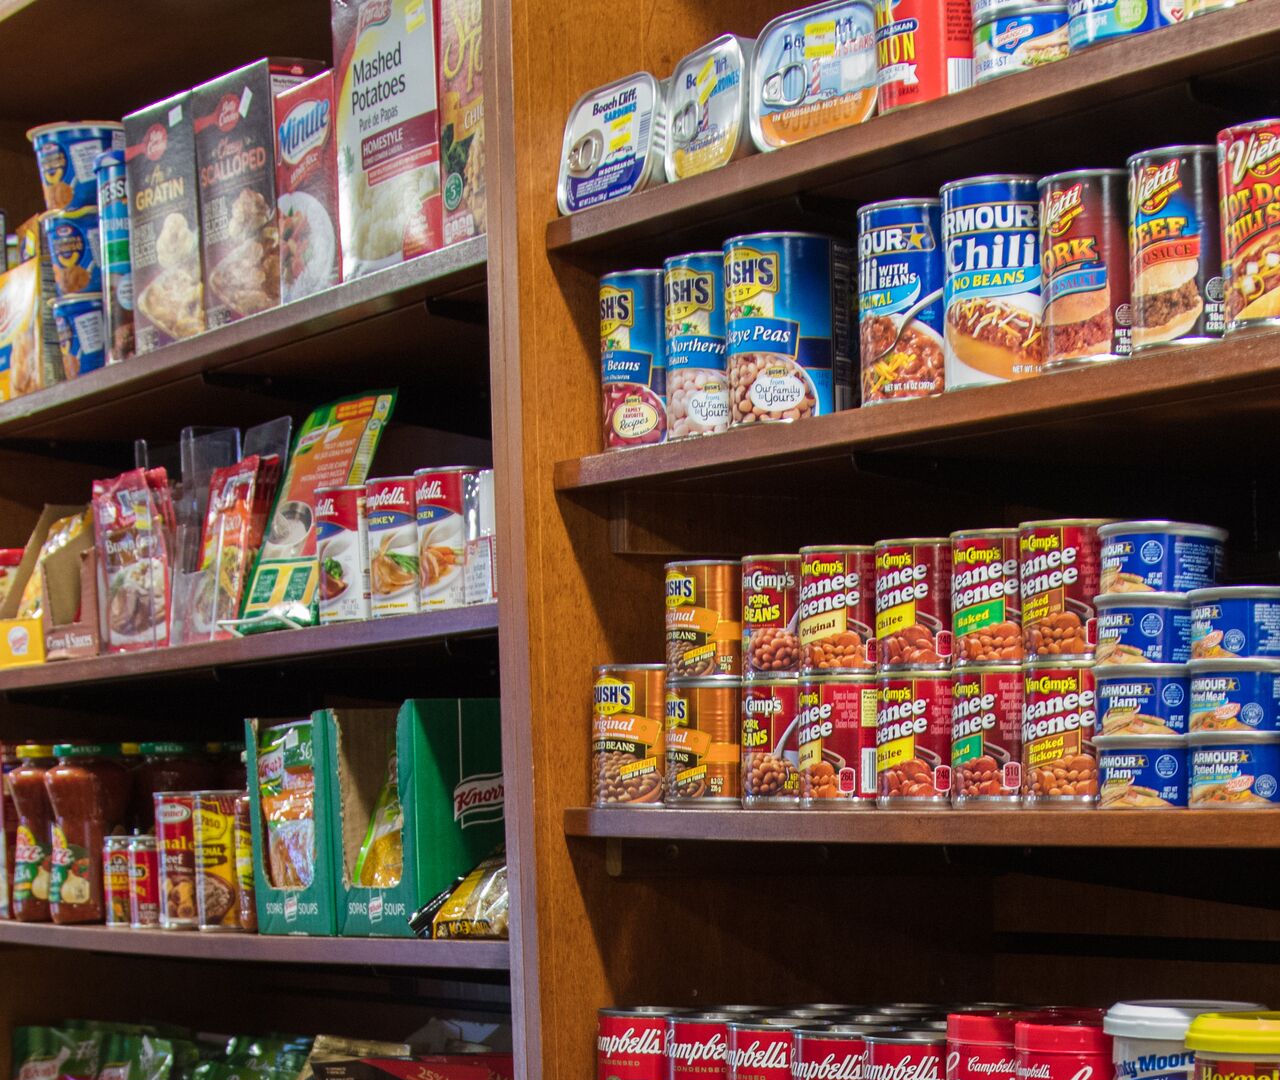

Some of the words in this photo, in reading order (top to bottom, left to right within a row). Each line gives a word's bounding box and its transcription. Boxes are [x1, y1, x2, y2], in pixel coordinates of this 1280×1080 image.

[353, 41, 402, 87] Mashed
[352, 73, 406, 115] Potatoes
[278, 101, 329, 155] Minute
[362, 128, 404, 154] HOMESTYLE
[201, 146, 265, 186] SCALLOPED
[136, 180, 184, 209] GRATIN
[947, 234, 1035, 273] Chili
[878, 263, 909, 277] WITH
[879, 274, 917, 289] BEANS
[953, 274, 970, 291] NO
[972, 270, 1025, 288] BEANS
[753, 324, 792, 344] Peas
[606, 359, 641, 373] Beans
[755, 384, 772, 395] Our
[772, 384, 801, 398] Family
[619, 417, 649, 431] Recipes
[748, 594, 770, 606] PORK
[877, 612, 904, 631] Chilee
[956, 608, 990, 628] Baked
[801, 619, 837, 638] Original
[1101, 683, 1143, 697] ARMOUR
[1109, 694, 1138, 709] Ham
[1029, 737, 1065, 755] Smoked
[1029, 747, 1066, 766] Hickory
[1099, 755, 1137, 768] ARMOUR
[1194, 751, 1240, 765] ARMOUR
[1105, 766, 1132, 780] Ham
[455, 784, 504, 808] Knorr
[298, 901, 318, 915] SOUPS
[348, 902, 368, 916] SOPAS
[383, 901, 406, 915] SOUPS
